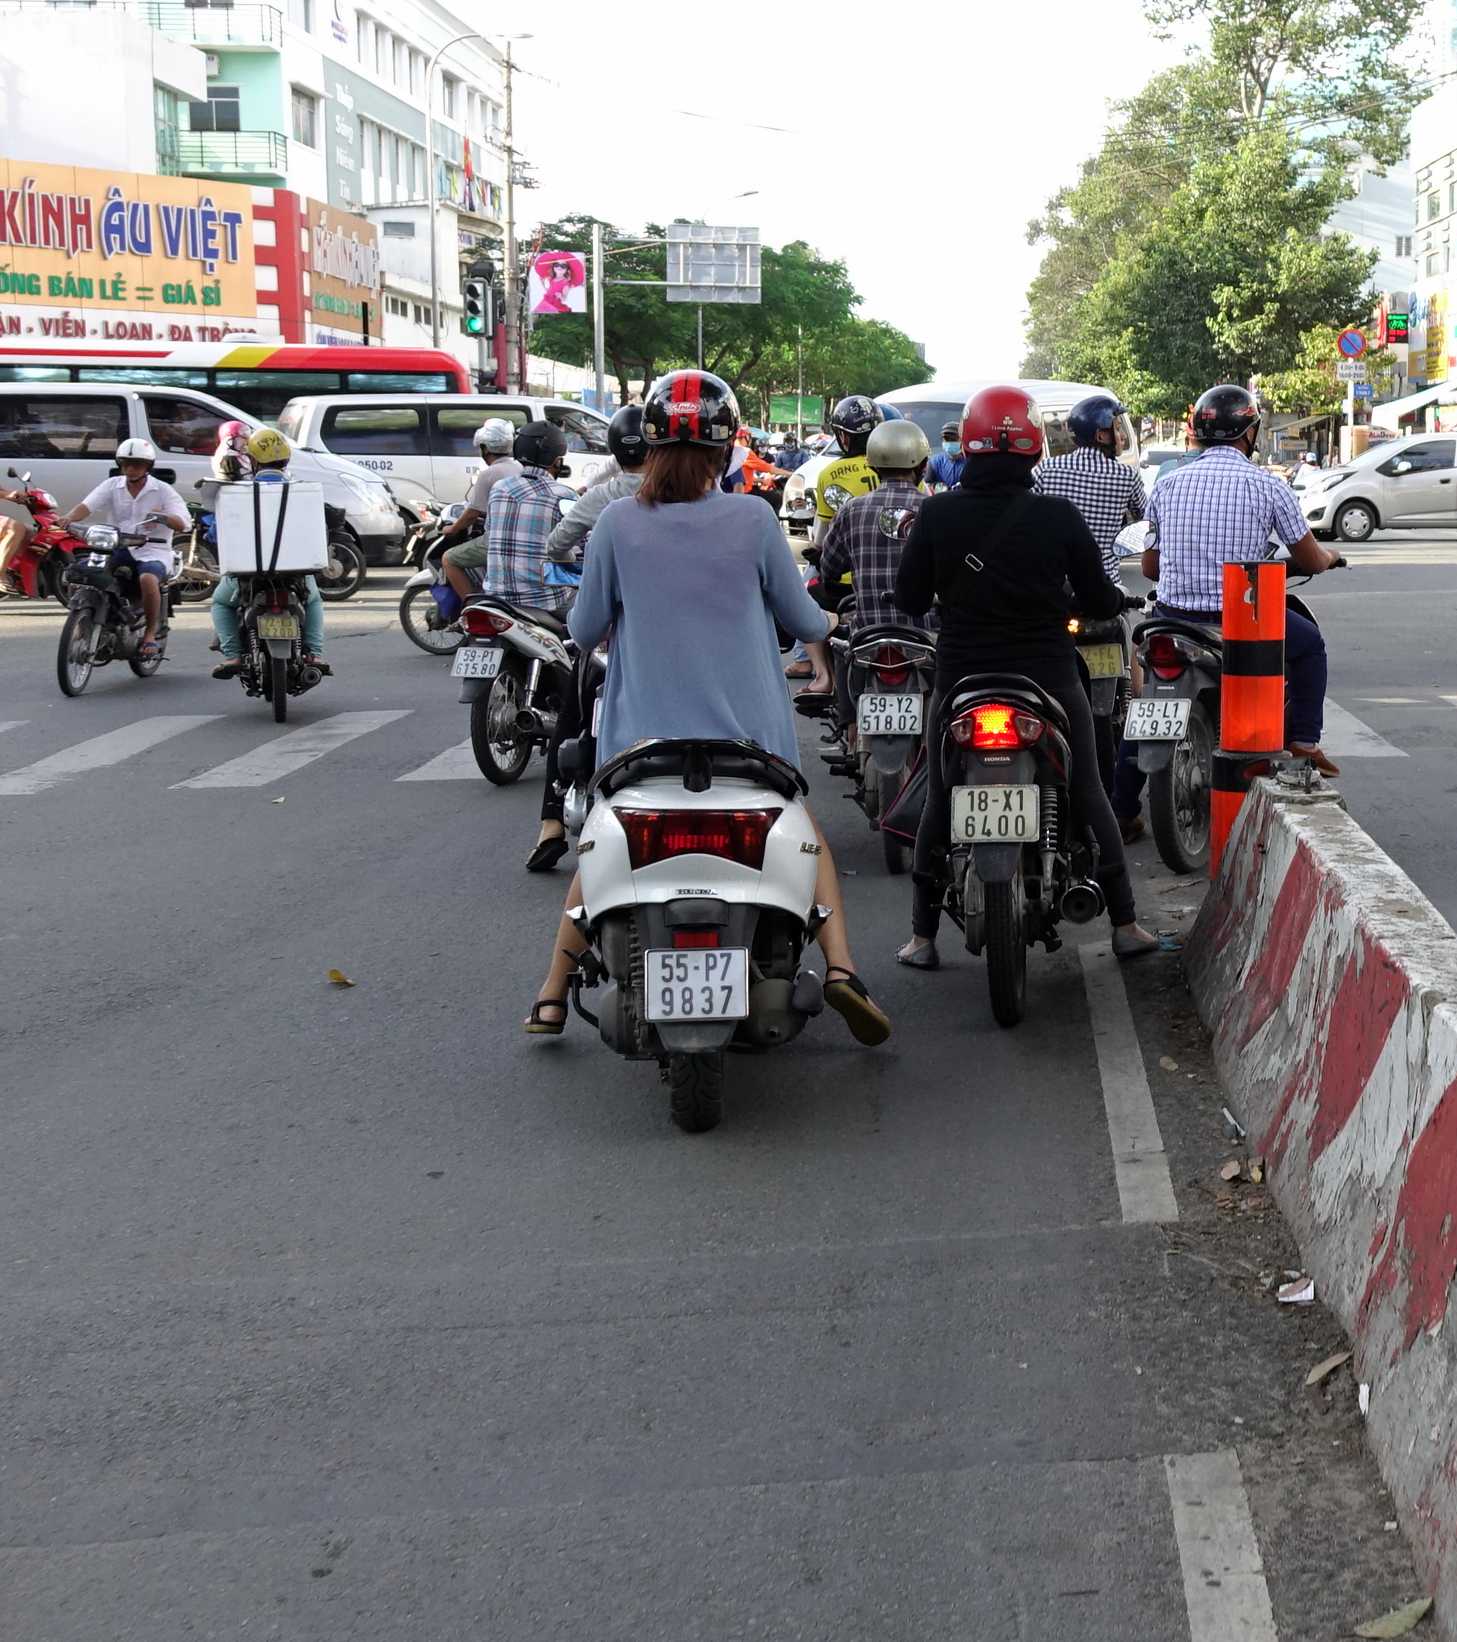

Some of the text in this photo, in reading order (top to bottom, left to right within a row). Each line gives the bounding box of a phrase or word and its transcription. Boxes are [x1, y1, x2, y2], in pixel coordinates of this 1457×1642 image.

[0, 176, 94, 258] KÍNH
[101, 186, 153, 260] ÂU
[161, 198, 243, 274] VIỆT
[48, 271, 94, 298] BÁN
[100, 271, 127, 301] LẺ
[162, 277, 197, 305] GIÁ
[201, 279, 222, 306] SỈ
[170, 324, 193, 341] ĐA
[463, 650, 494, 662] 59-P1
[869, 697, 913, 713] 59-Y2
[1138, 702, 1179, 718] 59-L1
[863, 715, 918, 731] 518.02
[1129, 720, 1183, 737] 649.32
[967, 790, 1024, 812] 18-X1
[965, 815, 1025, 837] 6400
[661, 953, 732, 983] 55-P7
[661, 986, 733, 1016] 9837
